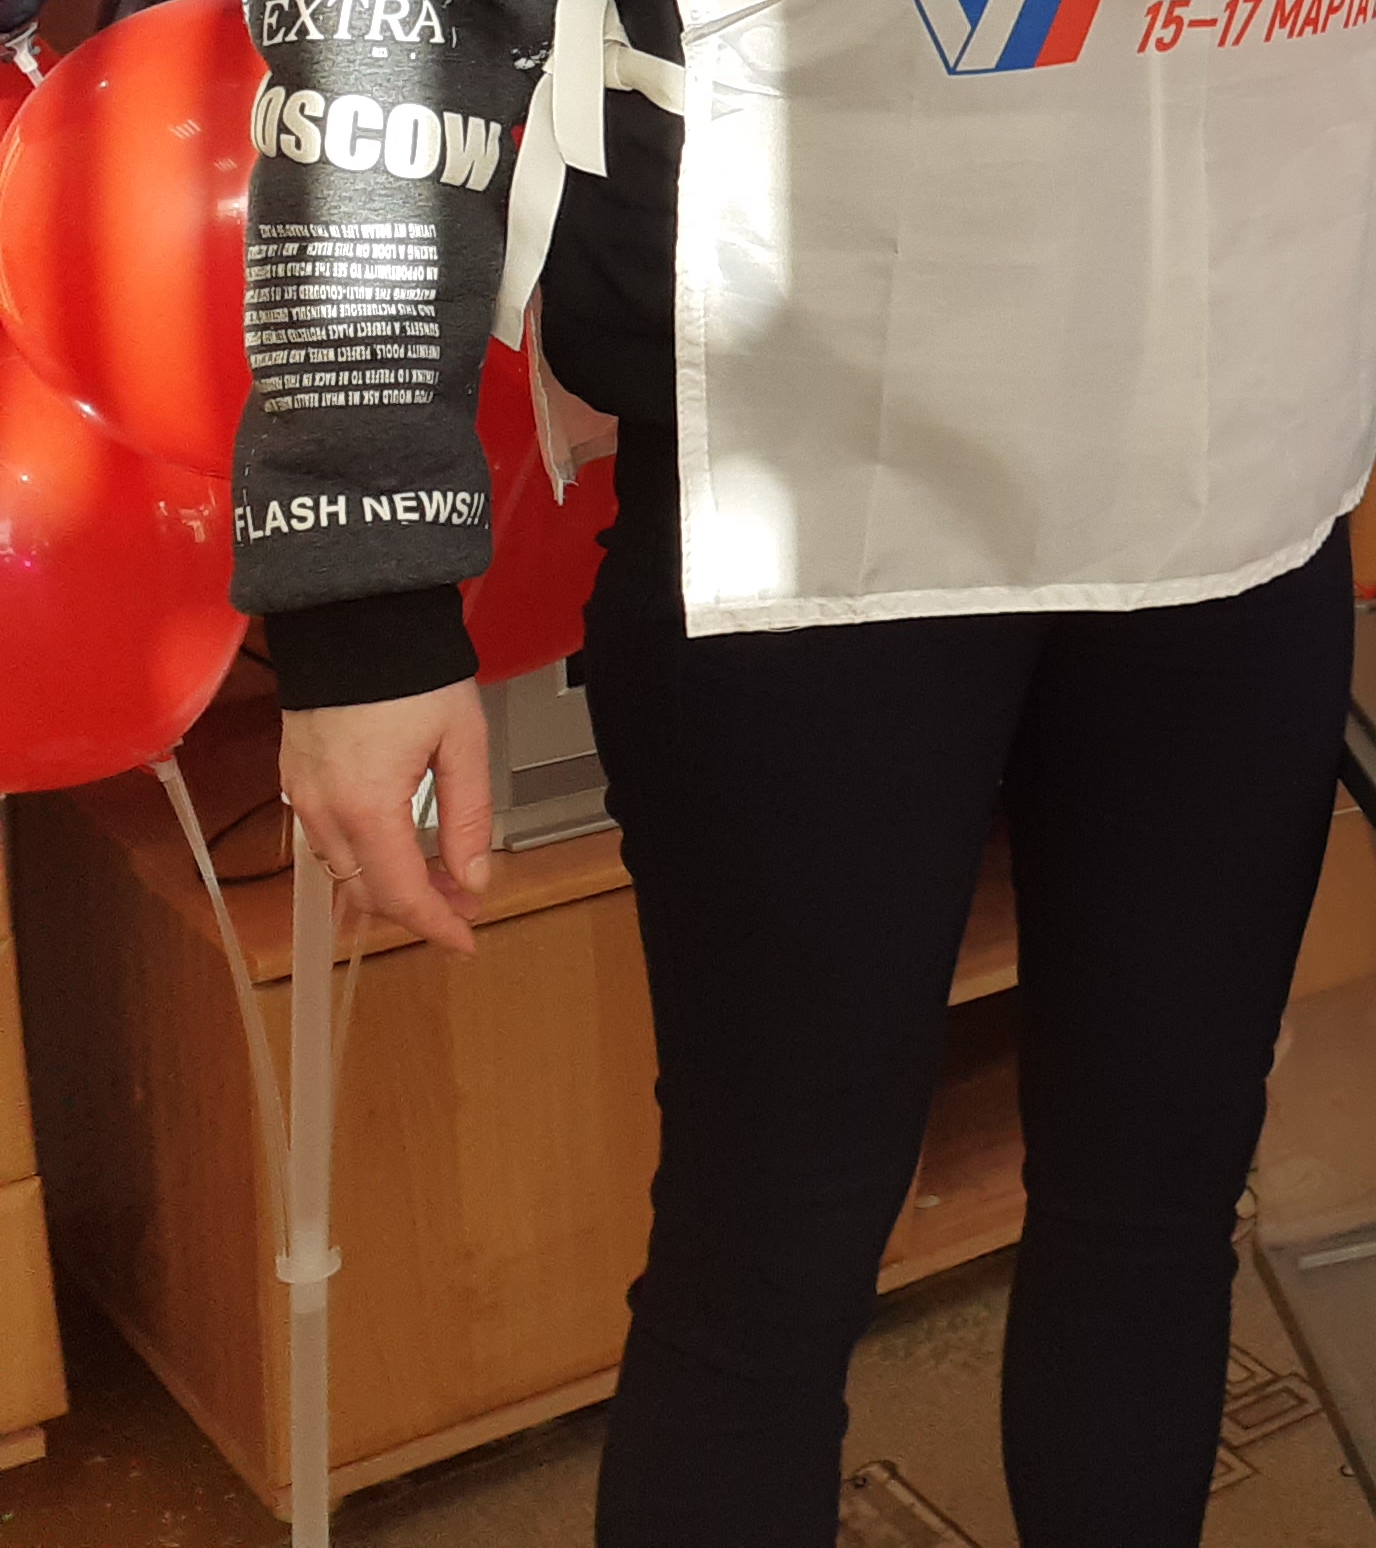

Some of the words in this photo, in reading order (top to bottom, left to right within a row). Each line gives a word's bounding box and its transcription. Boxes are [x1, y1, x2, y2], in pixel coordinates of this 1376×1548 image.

[251, 70, 502, 192] OSCOW
[372, 243, 396, 259] LOOK
[407, 245, 438, 260] TAKING
[315, 262, 330, 276] THE
[332, 262, 348, 278] SEE
[426, 266, 438, 280] AN
[375, 288, 391, 300] THE
[340, 303, 396, 317] PICTURESQUE
[328, 323, 354, 340] PLACE
[357, 322, 391, 337] PERFECT
[337, 345, 371, 361] PERFECT
[314, 372, 336, 386] BACK
[351, 370, 363, 384] TO
[365, 369, 394, 384] PREFER
[321, 390, 345, 406] WHAT
[348, 390, 360, 405] ME
[362, 390, 380, 405] ASK
[382, 389, 412, 404] WOULD
[234, 494, 347, 543] FLASH
